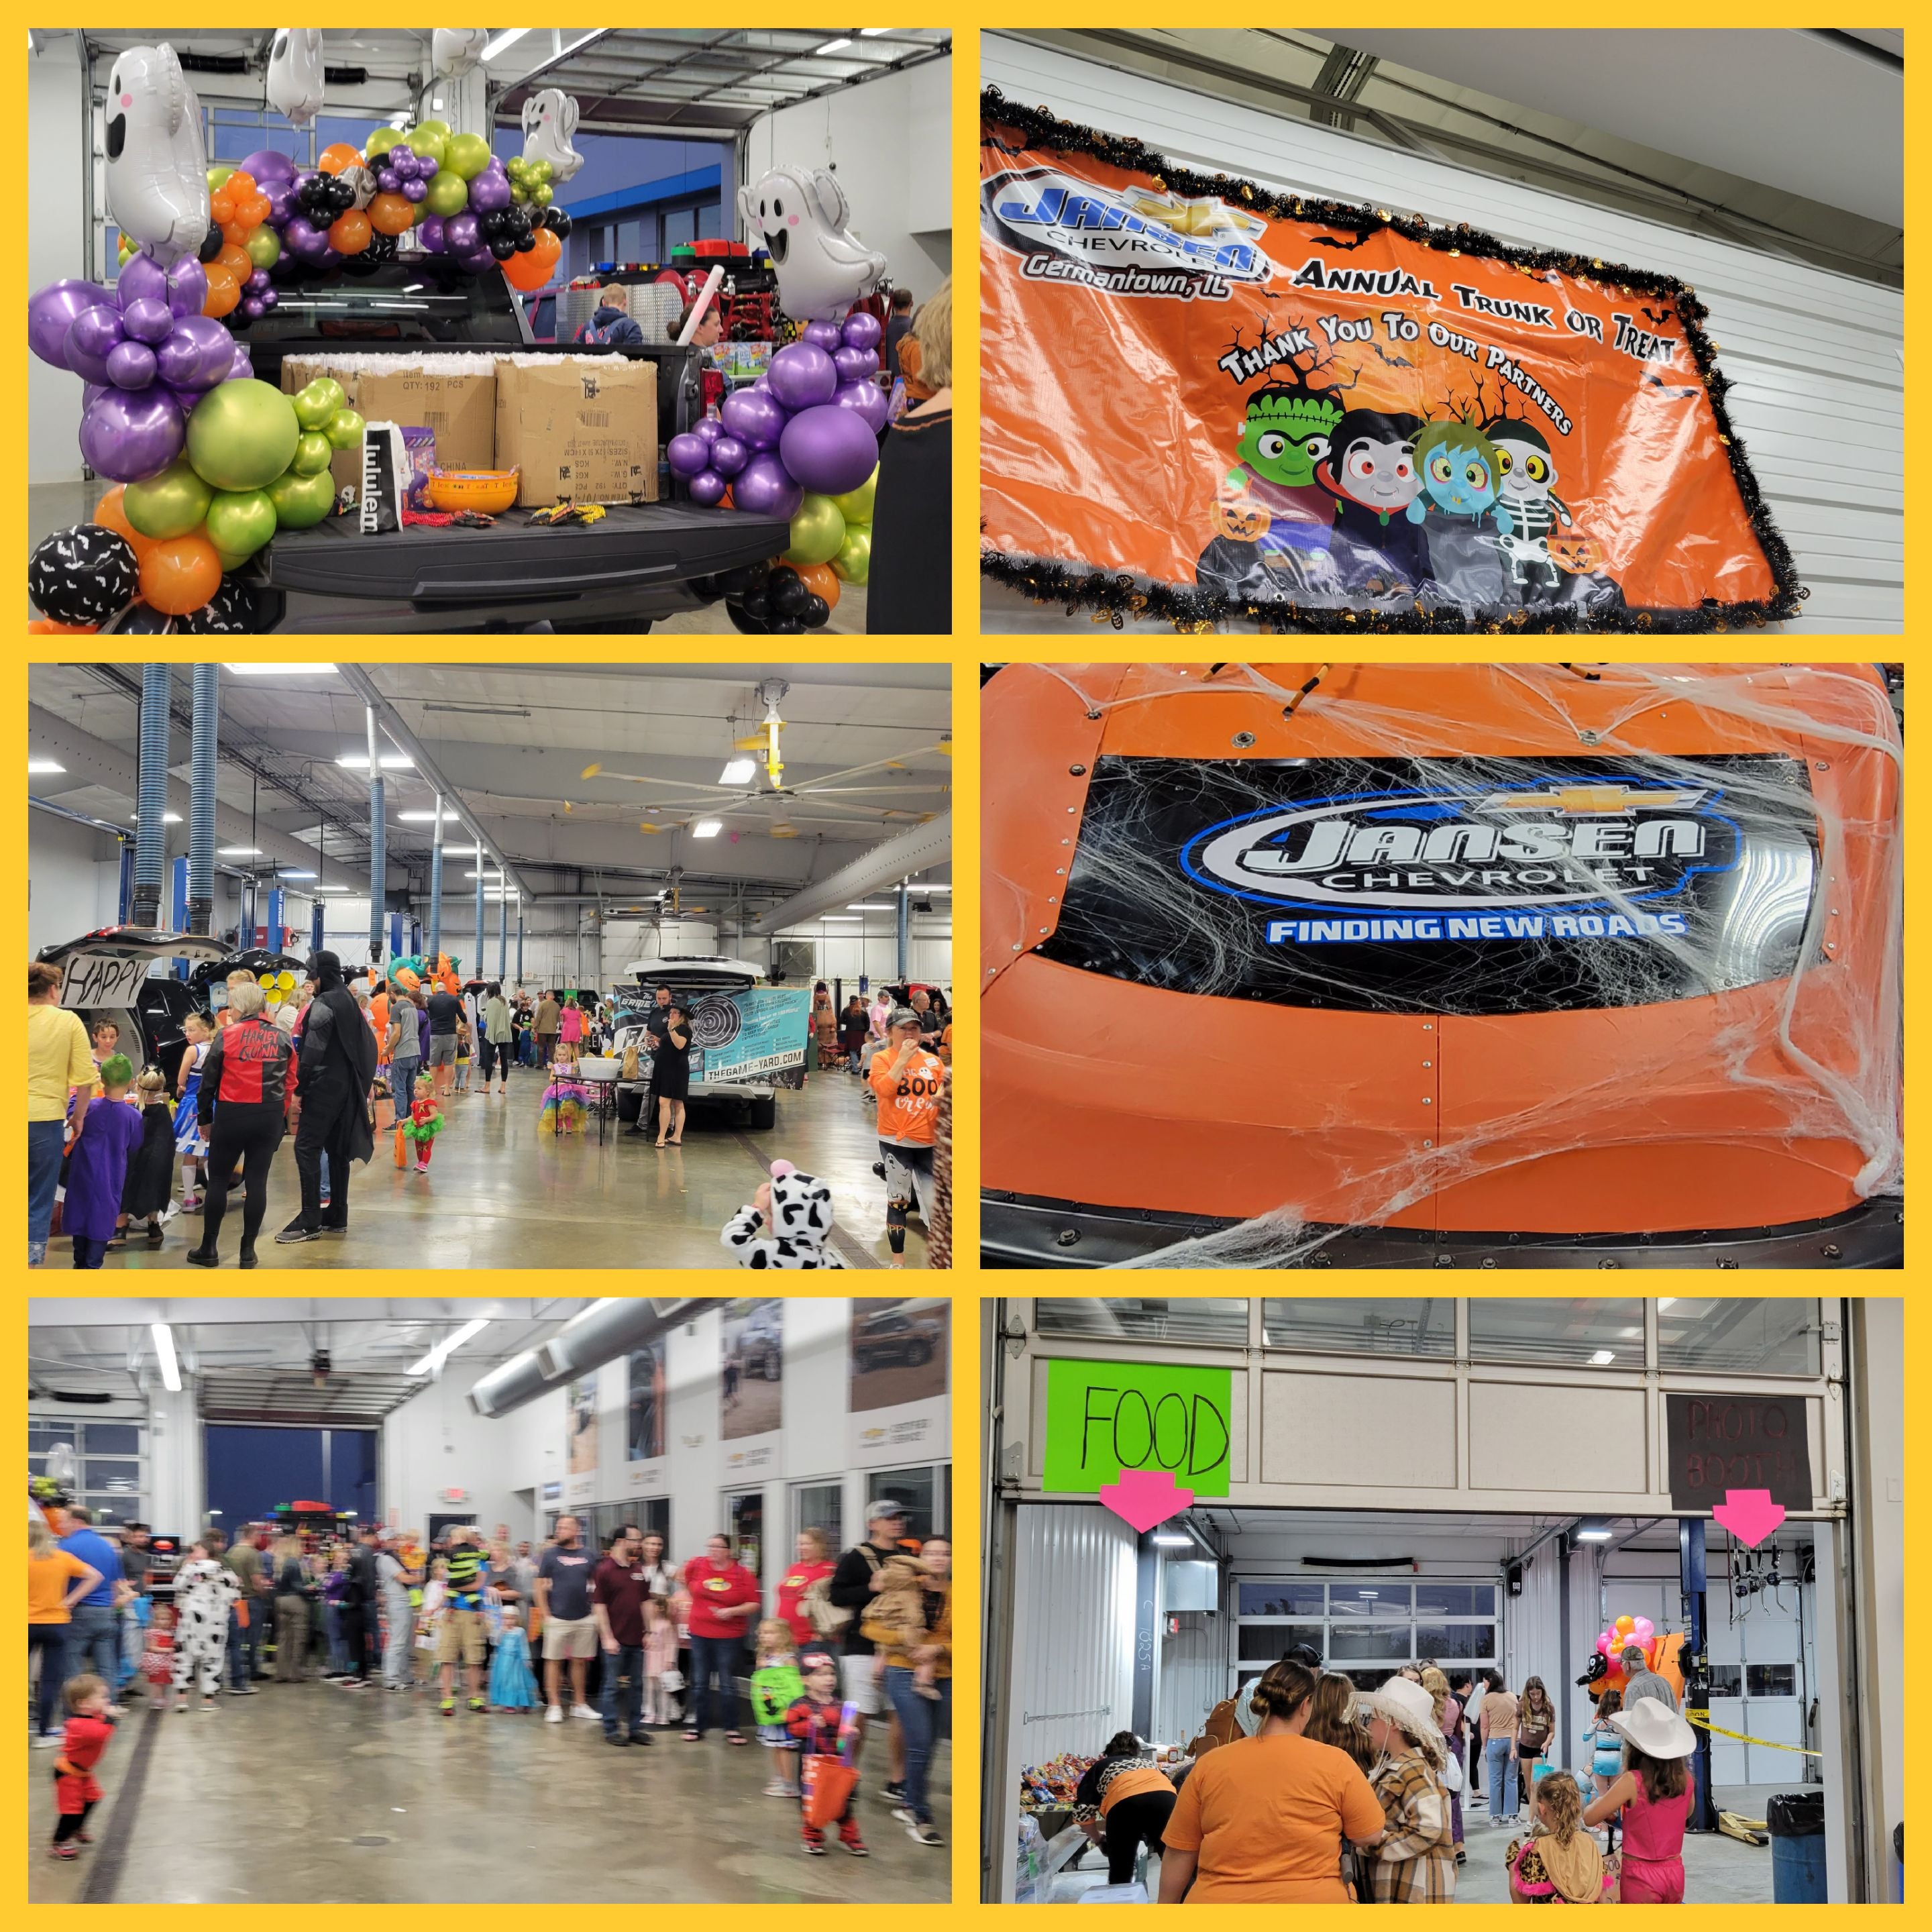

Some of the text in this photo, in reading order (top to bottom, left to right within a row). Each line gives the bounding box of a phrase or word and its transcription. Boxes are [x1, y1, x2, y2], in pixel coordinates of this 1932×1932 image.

[999, 188, 1257, 270] JANSEN
[1046, 230, 1224, 270] CHEVROLET
[1027, 254, 1228, 295] Germantown, IL
[1293, 260, 1675, 362] ANNUAL TRUNK OR TREAT
[403, 380, 464, 391] QTY: 192 PCS
[1220, 313, 1571, 435] THANK YOU TO OUR PARTNERS
[440, 462, 467, 471] CHINA
[1243, 820, 1706, 873] JANSEN
[1322, 867, 1655, 888] CHEVROLET
[1269, 914, 1686, 942] FINDING NEW ROADS
[61, 957, 149, 1005] HAPPY
[239, 1044, 278, 1062] QUINN
[240, 1028, 279, 1045] HARLEY
[708, 1051, 802, 1081] THEGAME-YARD.COM
[897, 1077, 938, 1097] BOO
[1081, 1386, 1230, 1476] FOOD
[1687, 1400, 1788, 1440] PHOTO
[1686, 1451, 1797, 1489] BOOTH
